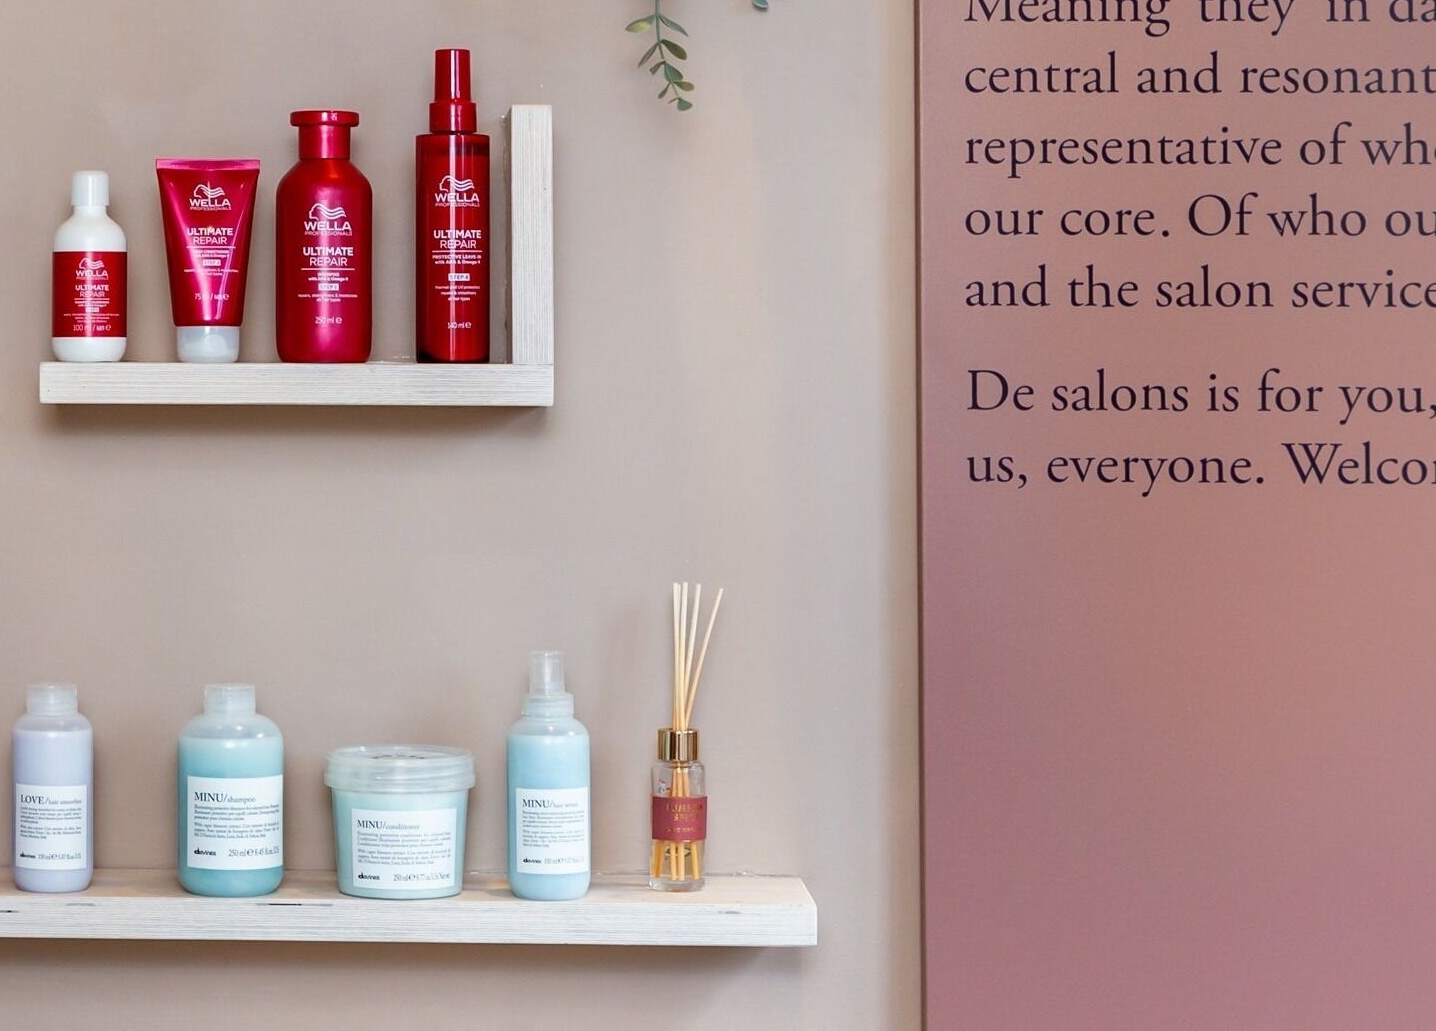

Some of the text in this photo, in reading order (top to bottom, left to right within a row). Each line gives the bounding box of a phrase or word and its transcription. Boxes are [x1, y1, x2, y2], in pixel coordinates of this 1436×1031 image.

[964, 49, 1436, 94] central and resonant
[964, 120, 1436, 179] representative of wh
[189, 198, 232, 207] WELLA
[434, 192, 480, 203] WELLA
[964, 191, 1436, 238] our core. Of who ou
[186, 227, 234, 236] ULTIMATE
[304, 221, 352, 231] WELLA
[433, 229, 482, 239] ULTIMATE
[192, 236, 228, 245] REPAIR
[439, 239, 477, 249] REPAIR
[302, 246, 354, 257] ULTIMATE
[309, 256, 348, 267] REPAIR
[965, 263, 1051, 307] and
[1067, 263, 1139, 308] the
[1155, 263, 1274, 308] salon
[966, 367, 1436, 426] De salons is for you,
[966, 440, 1436, 498] us, everyone. Welco
